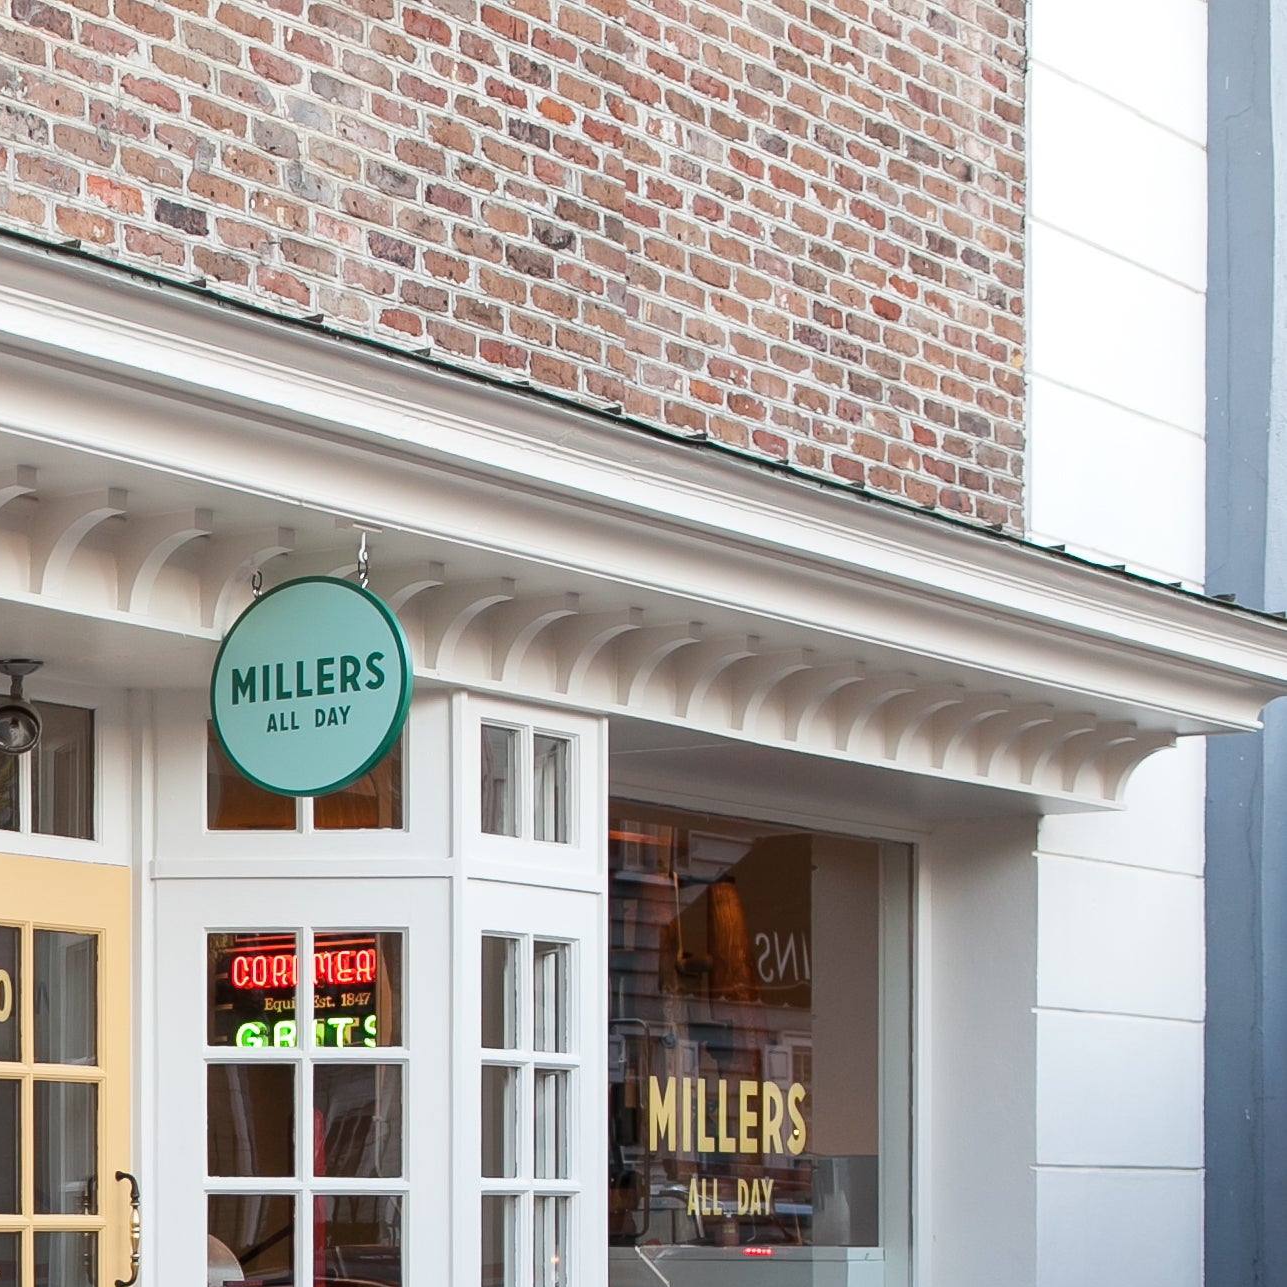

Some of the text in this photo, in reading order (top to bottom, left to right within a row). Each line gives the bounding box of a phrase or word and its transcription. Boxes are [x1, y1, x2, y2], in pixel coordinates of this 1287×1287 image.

[231, 651, 386, 706] MILLERS
[266, 705, 352, 733] ALL DAY
[340, 992, 371, 1007] 1847
[649, 1075, 807, 1156] MILLERS
[687, 1178, 774, 1216] ALL DAY
